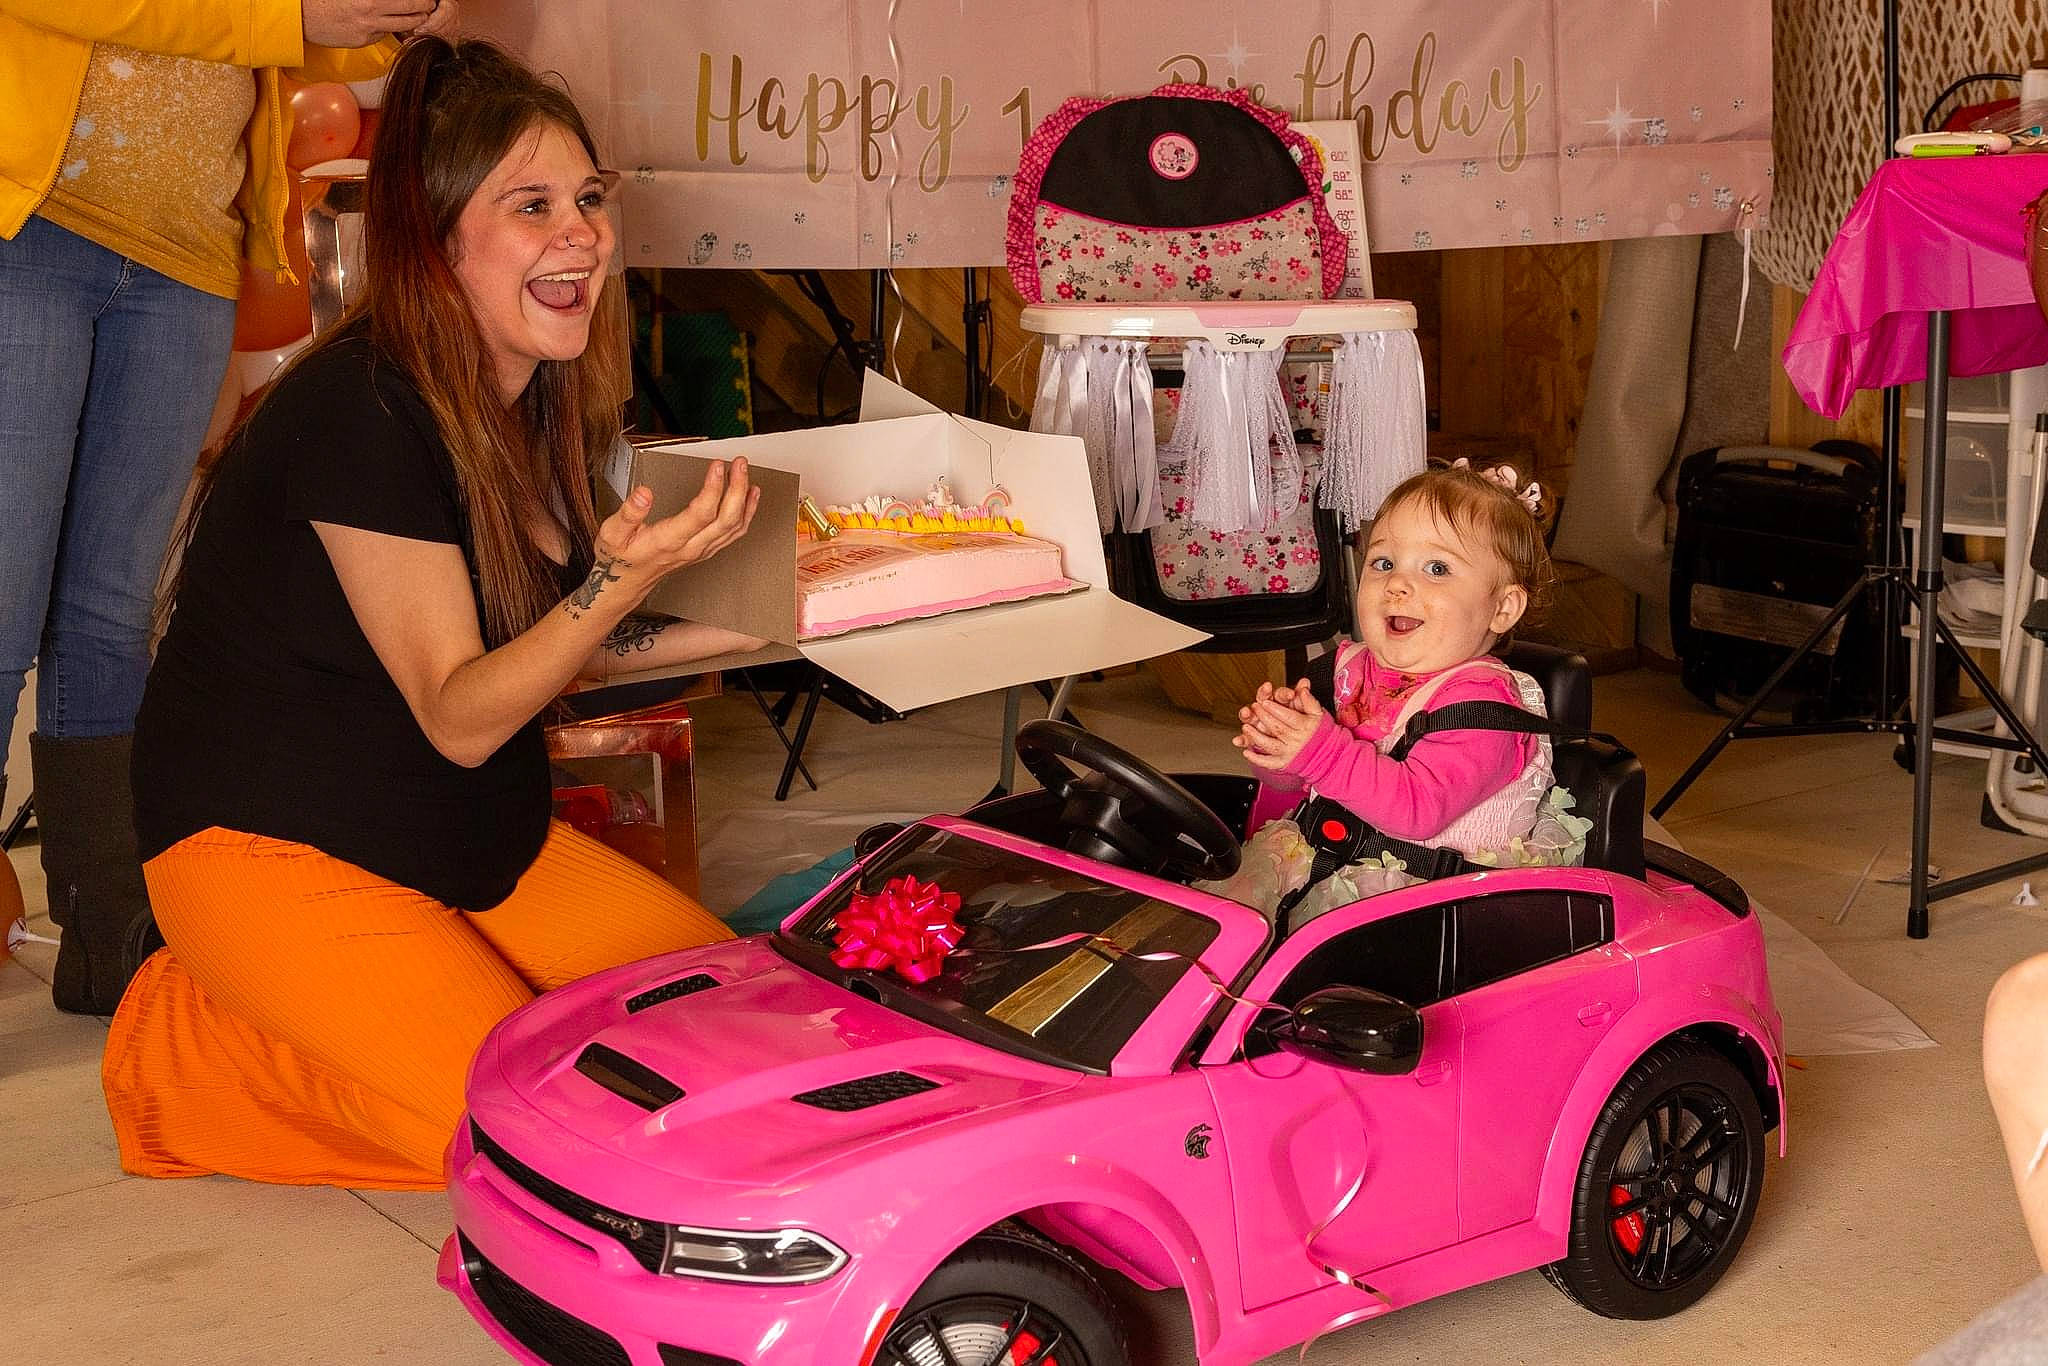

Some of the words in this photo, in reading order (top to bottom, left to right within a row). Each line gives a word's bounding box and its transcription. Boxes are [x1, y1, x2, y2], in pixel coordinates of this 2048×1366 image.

[695, 52, 970, 192] Happy
[1158, 31, 1542, 173] thday
[1224, 332, 1265, 349] Disney
